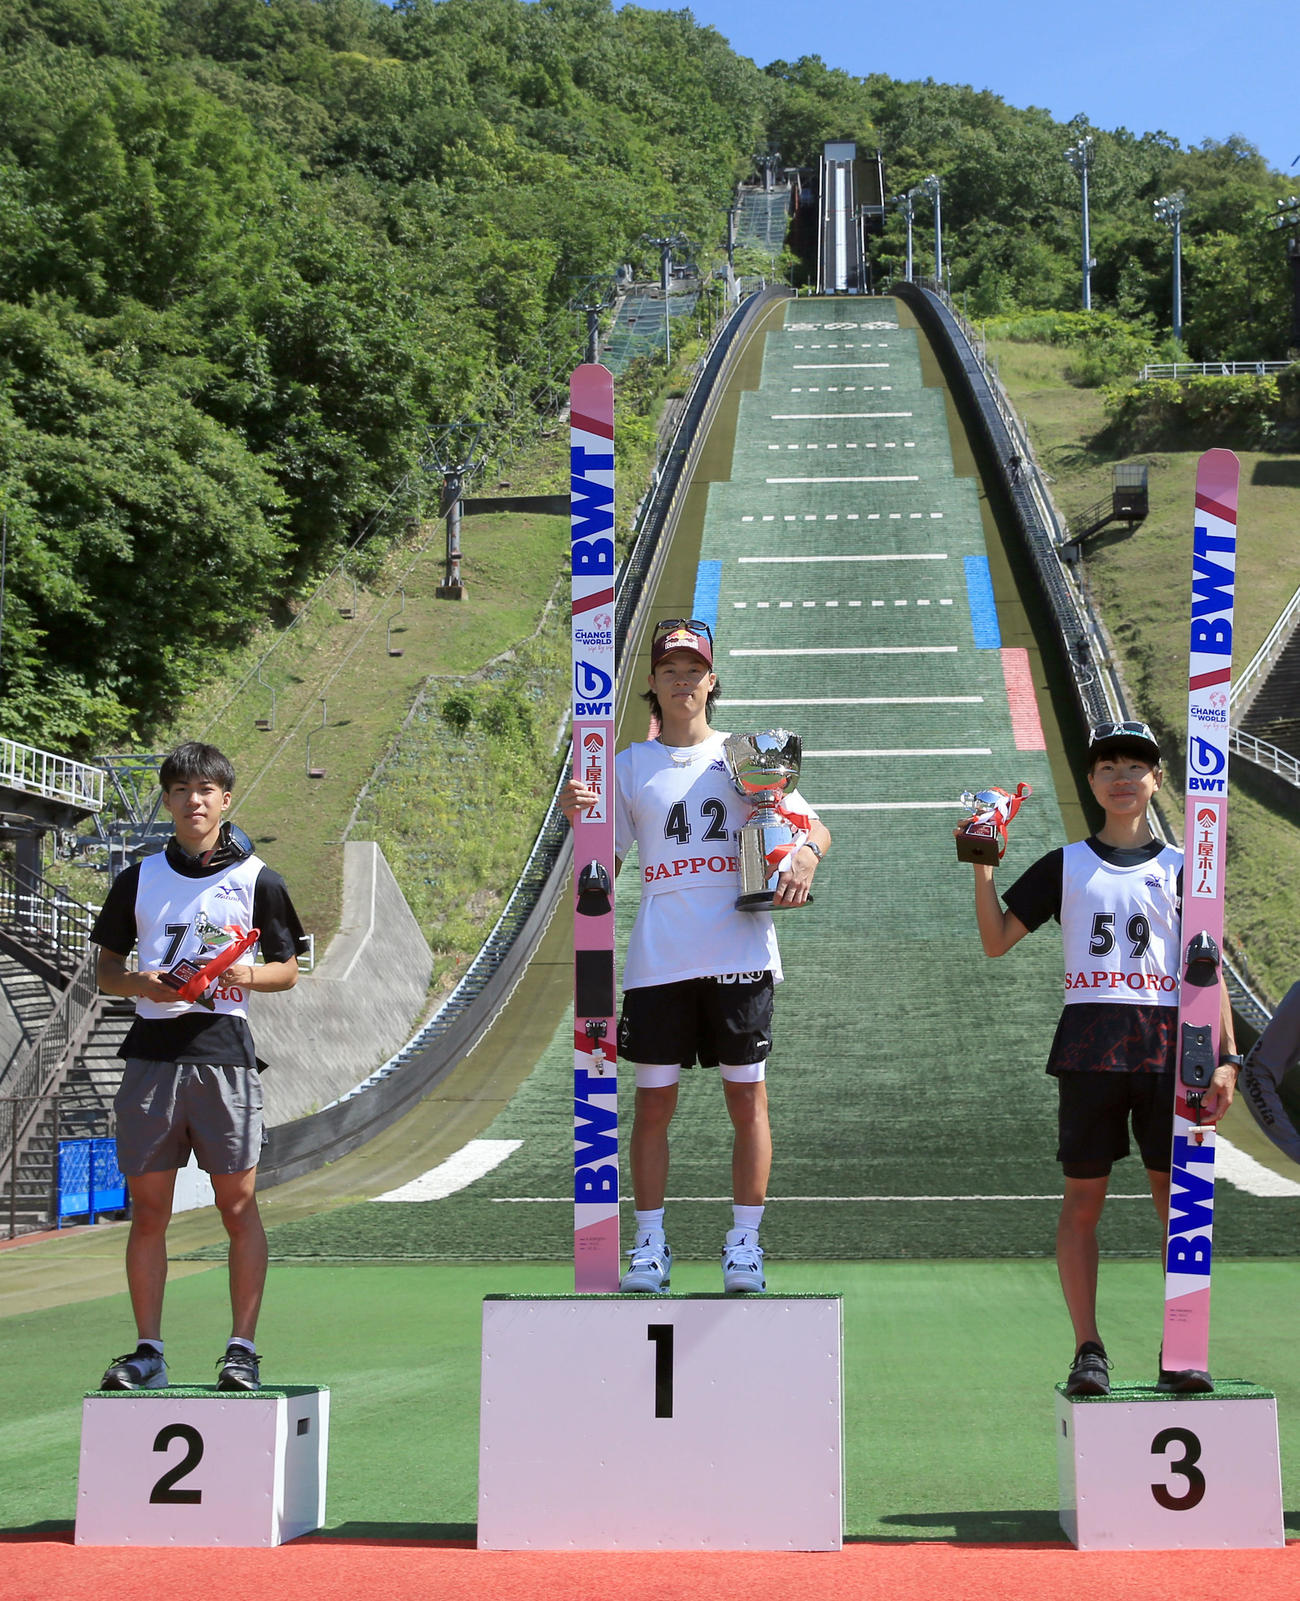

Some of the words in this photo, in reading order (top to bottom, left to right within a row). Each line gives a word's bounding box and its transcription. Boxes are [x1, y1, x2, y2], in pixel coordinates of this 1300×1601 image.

[570, 446, 614, 576] BWT
[1190, 526, 1236, 655] BWT
[575, 702, 612, 715] BWT
[1190, 707, 1227, 716] CHANGE
[1198, 715, 1226, 723] WORLD
[586, 755, 602, 818] 土屋ホム
[1189, 777, 1225, 791] BWT
[665, 797, 728, 844] 42
[1196, 830, 1214, 893] 土屋ホーム
[1089, 912, 1150, 958] 59
[1065, 971, 1177, 992] SAPPORO
[574, 1069, 618, 1204] BWT
[1166, 1135, 1216, 1276] BWT
[648, 1324, 674, 1419] 1
[149, 1423, 204, 1505] 2
[1150, 1427, 1206, 1511] 3
